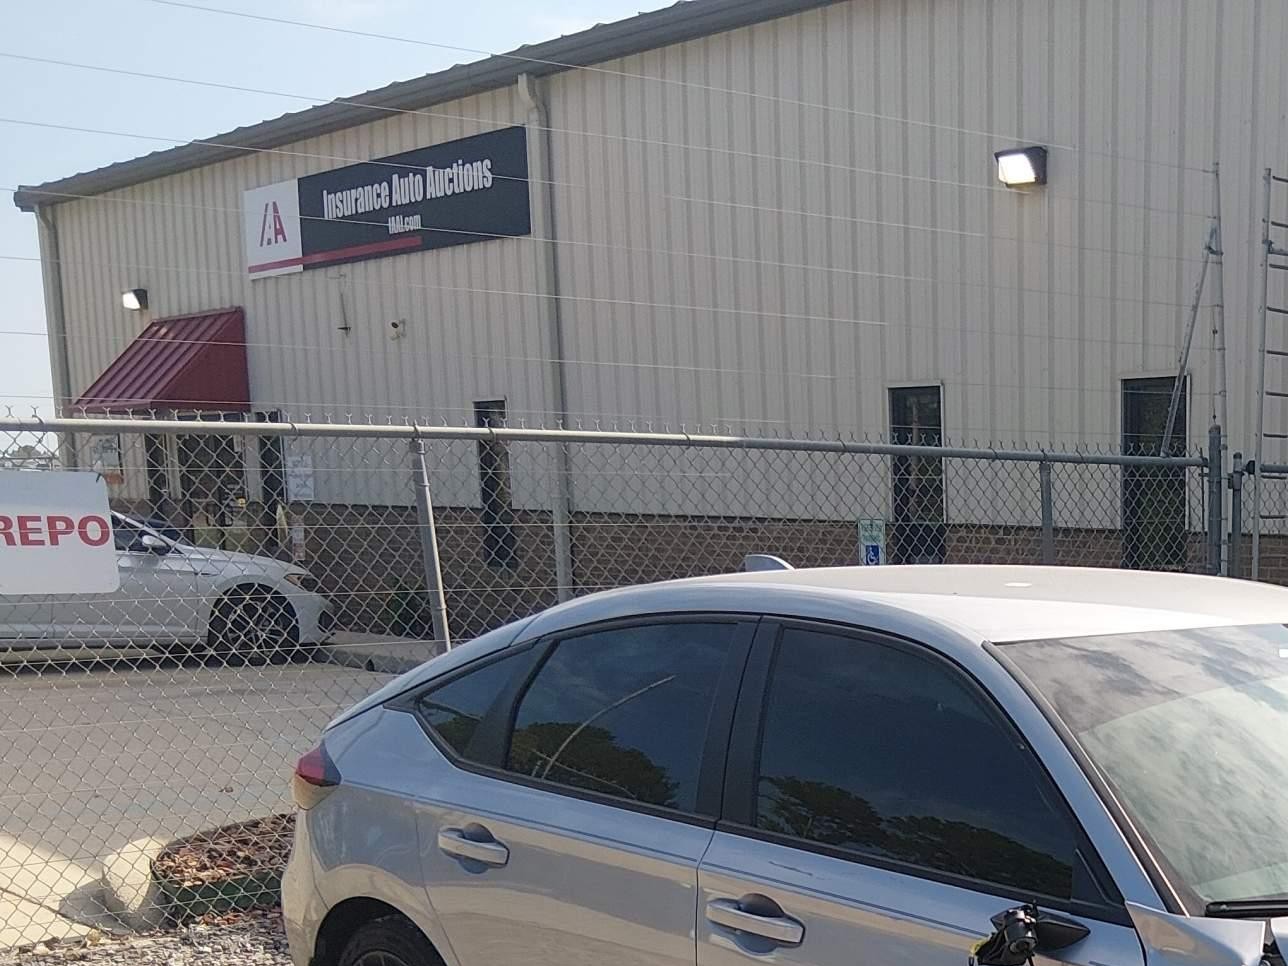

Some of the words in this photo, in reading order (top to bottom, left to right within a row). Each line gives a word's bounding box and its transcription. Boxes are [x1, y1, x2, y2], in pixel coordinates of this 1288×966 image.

[323, 181, 389, 220] Insurance
[392, 172, 423, 206] Auto
[426, 159, 493, 199] Auctions
